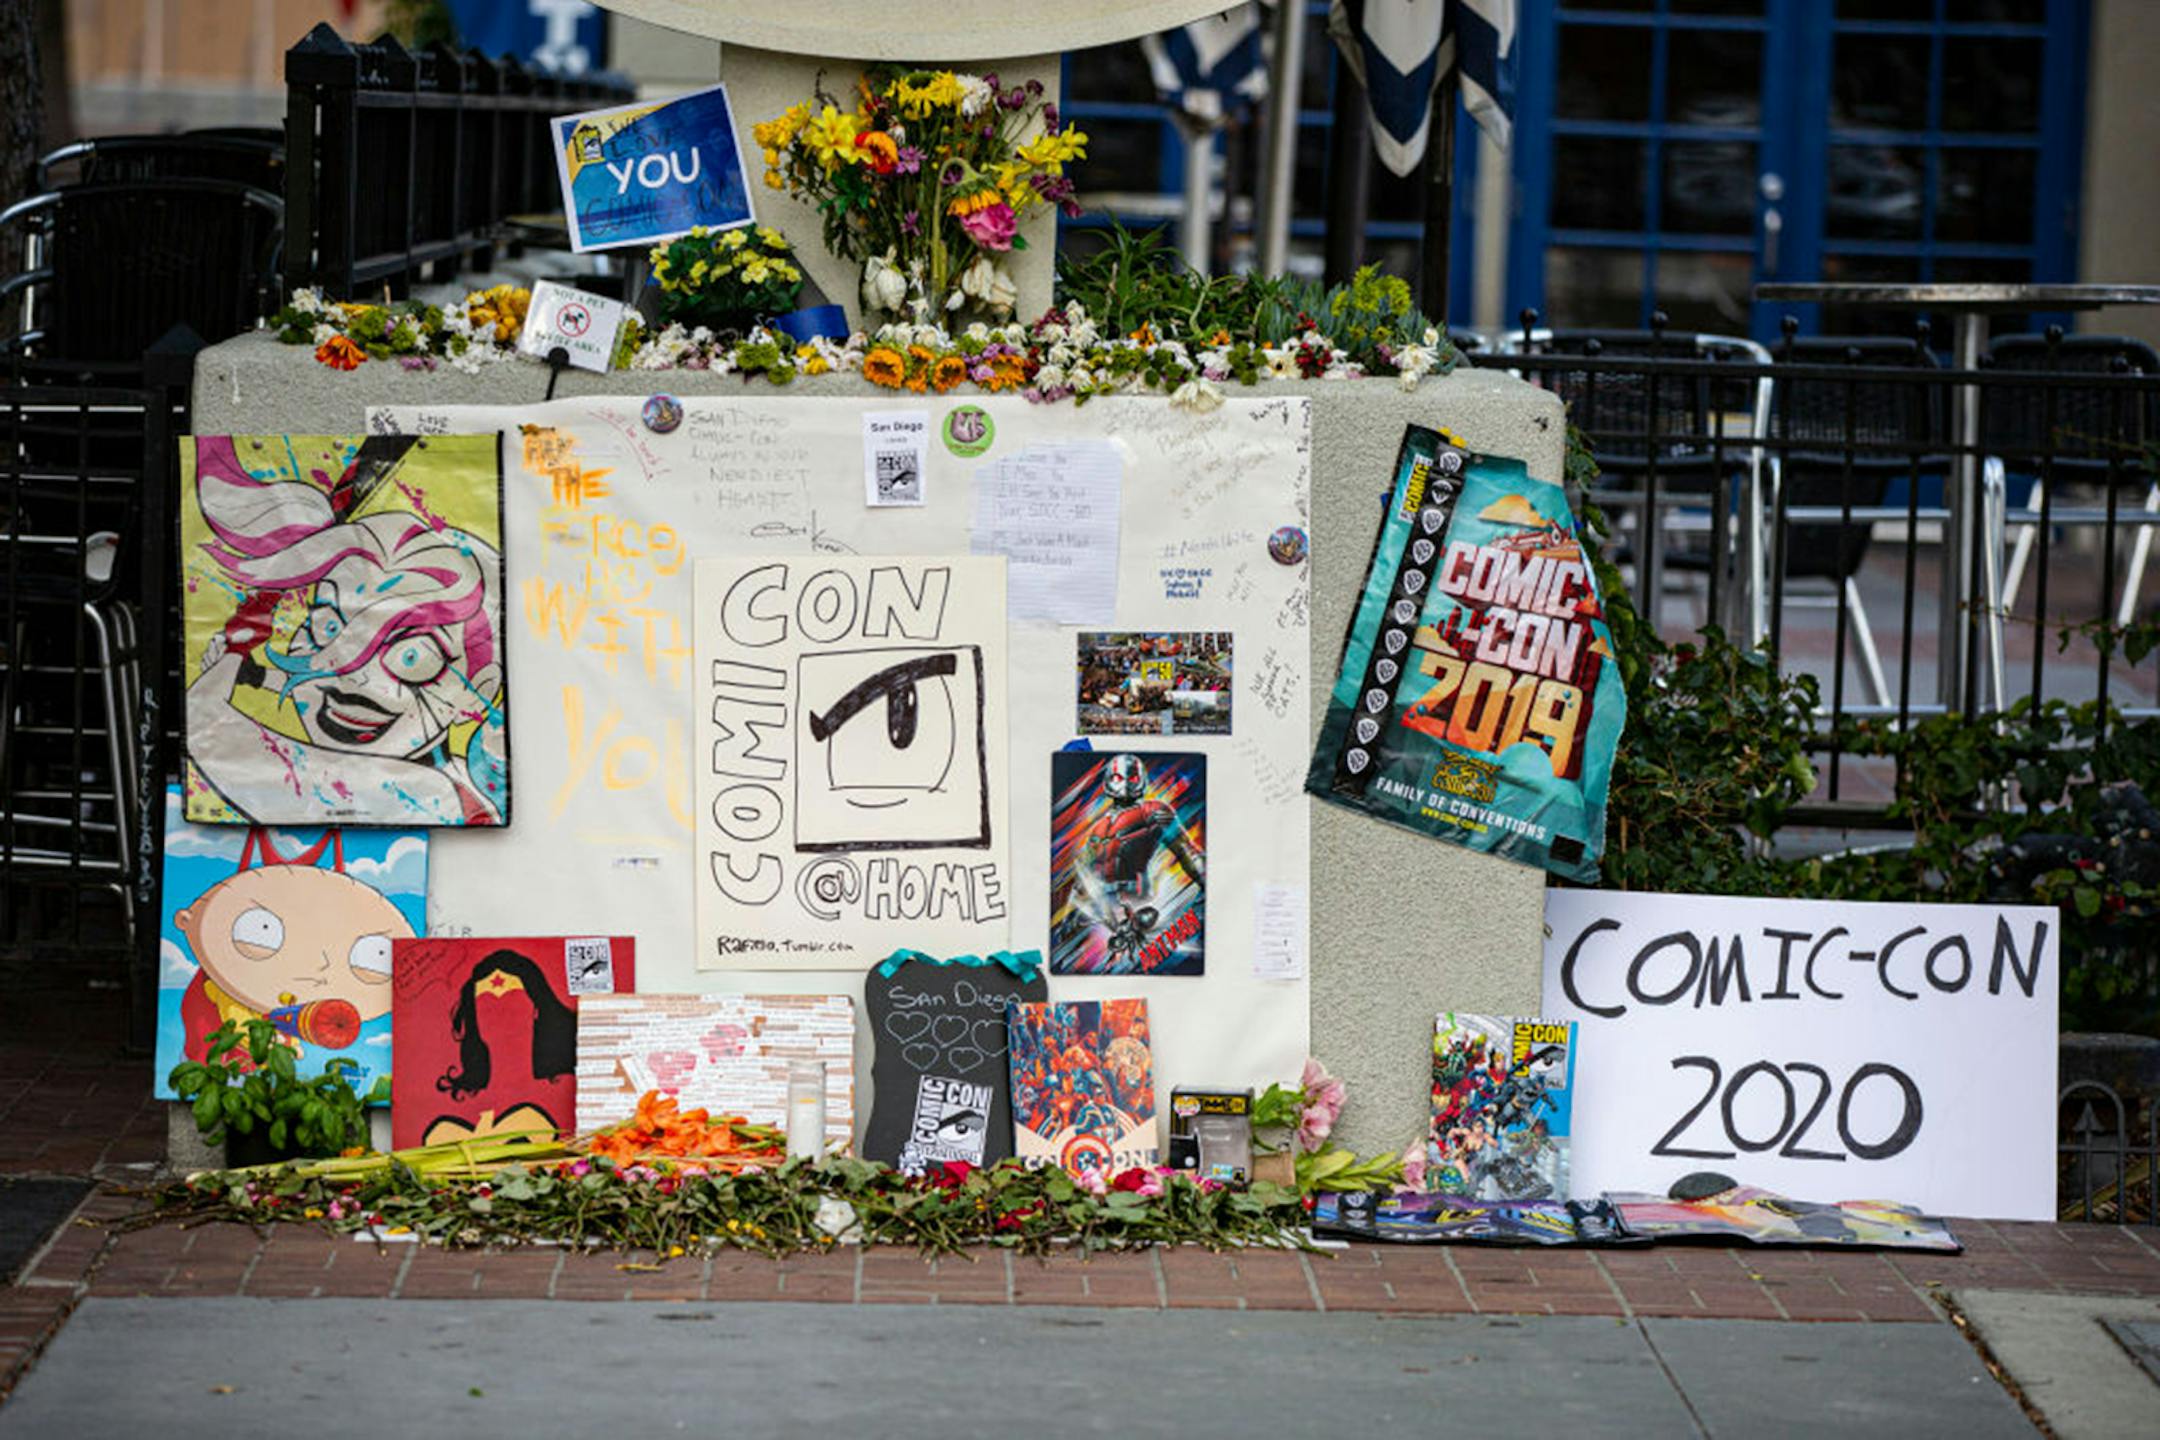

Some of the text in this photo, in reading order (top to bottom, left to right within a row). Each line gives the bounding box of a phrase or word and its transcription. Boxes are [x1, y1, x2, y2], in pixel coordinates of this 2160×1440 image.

[605, 146, 700, 195] YOU
[893, 420, 923, 434] Diego
[550, 464, 614, 509] THE
[1403, 463, 1430, 513] COMIC
[720, 563, 951, 648] CON
[1437, 539, 1585, 621] COMIC
[1400, 653, 1584, 779] 2019
[1376, 776, 1426, 803] FAMILY
[1428, 792, 1447, 809] OF
[1449, 799, 1548, 841] CONVENTIONS
[794, 855, 1006, 924] @HOME
[888, 980, 1023, 1014] San Diego
[1533, 1026, 1569, 1045] CON
[915, 1079, 946, 1144] COMIC
[945, 1082, 990, 1109] CON
[1650, 1055, 1925, 1161] 2020
